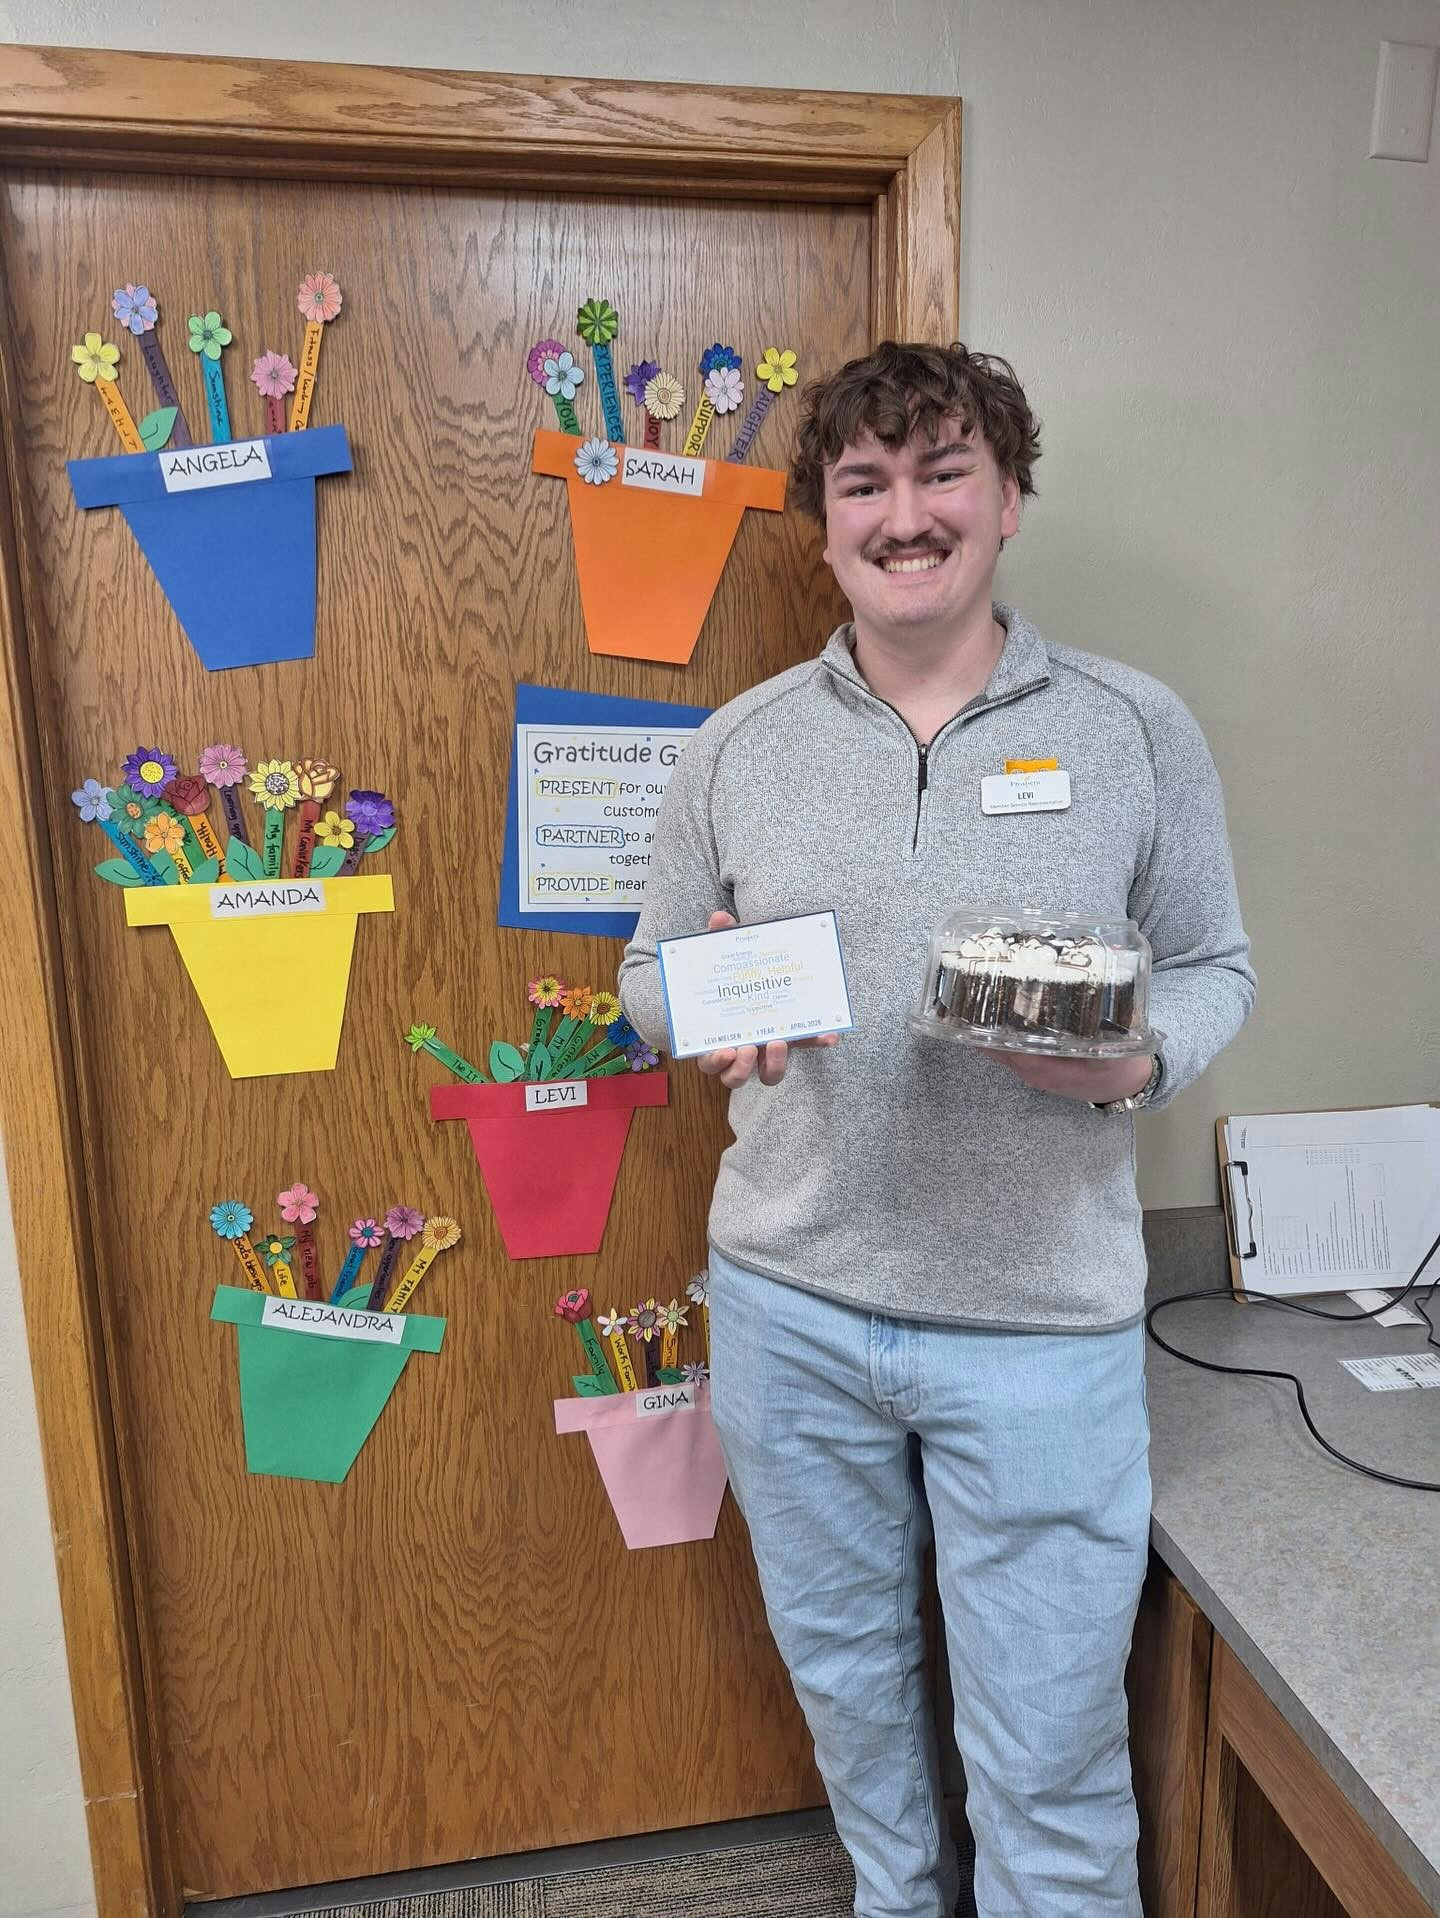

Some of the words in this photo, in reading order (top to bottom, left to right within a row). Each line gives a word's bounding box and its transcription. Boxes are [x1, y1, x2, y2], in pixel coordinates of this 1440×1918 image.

[143, 343, 175, 404] Laughter
[208, 370, 223, 426] Sunshine
[594, 343, 624, 443] EXPERIENCES
[558, 400, 577, 432] YOU
[168, 445, 263, 477] ANGELA
[625, 458, 696, 486] SARAH
[533, 741, 652, 765] Gratitude
[659, 745, 685, 767] G
[539, 779, 616, 797] PRESENT
[619, 781, 642, 795] for
[1017, 792, 1034, 800] LEVI
[265, 823, 280, 840] My
[541, 828, 623, 845] PARTNER
[625, 832, 641, 843] to
[264, 842, 280, 878] family
[536, 876, 610, 892] PROVIDE
[217, 887, 320, 909] AMANDA
[713, 953, 790, 974] Compassionate
[767, 961, 804, 976] Helpful
[717, 975, 792, 998] Inquisitive
[704, 1037, 717, 1045] LEVI
[452, 1057, 467, 1072] The
[534, 1086, 577, 1104] LEVI
[276, 1267, 288, 1286] Life
[303, 1271, 316, 1289] job
[390, 1278, 414, 1314] FAMILY
[272, 1303, 395, 1332] ALEJANDRA
[585, 1336, 606, 1378] Family
[614, 1338, 627, 1364] Work
[643, 1391, 689, 1411] GINA
